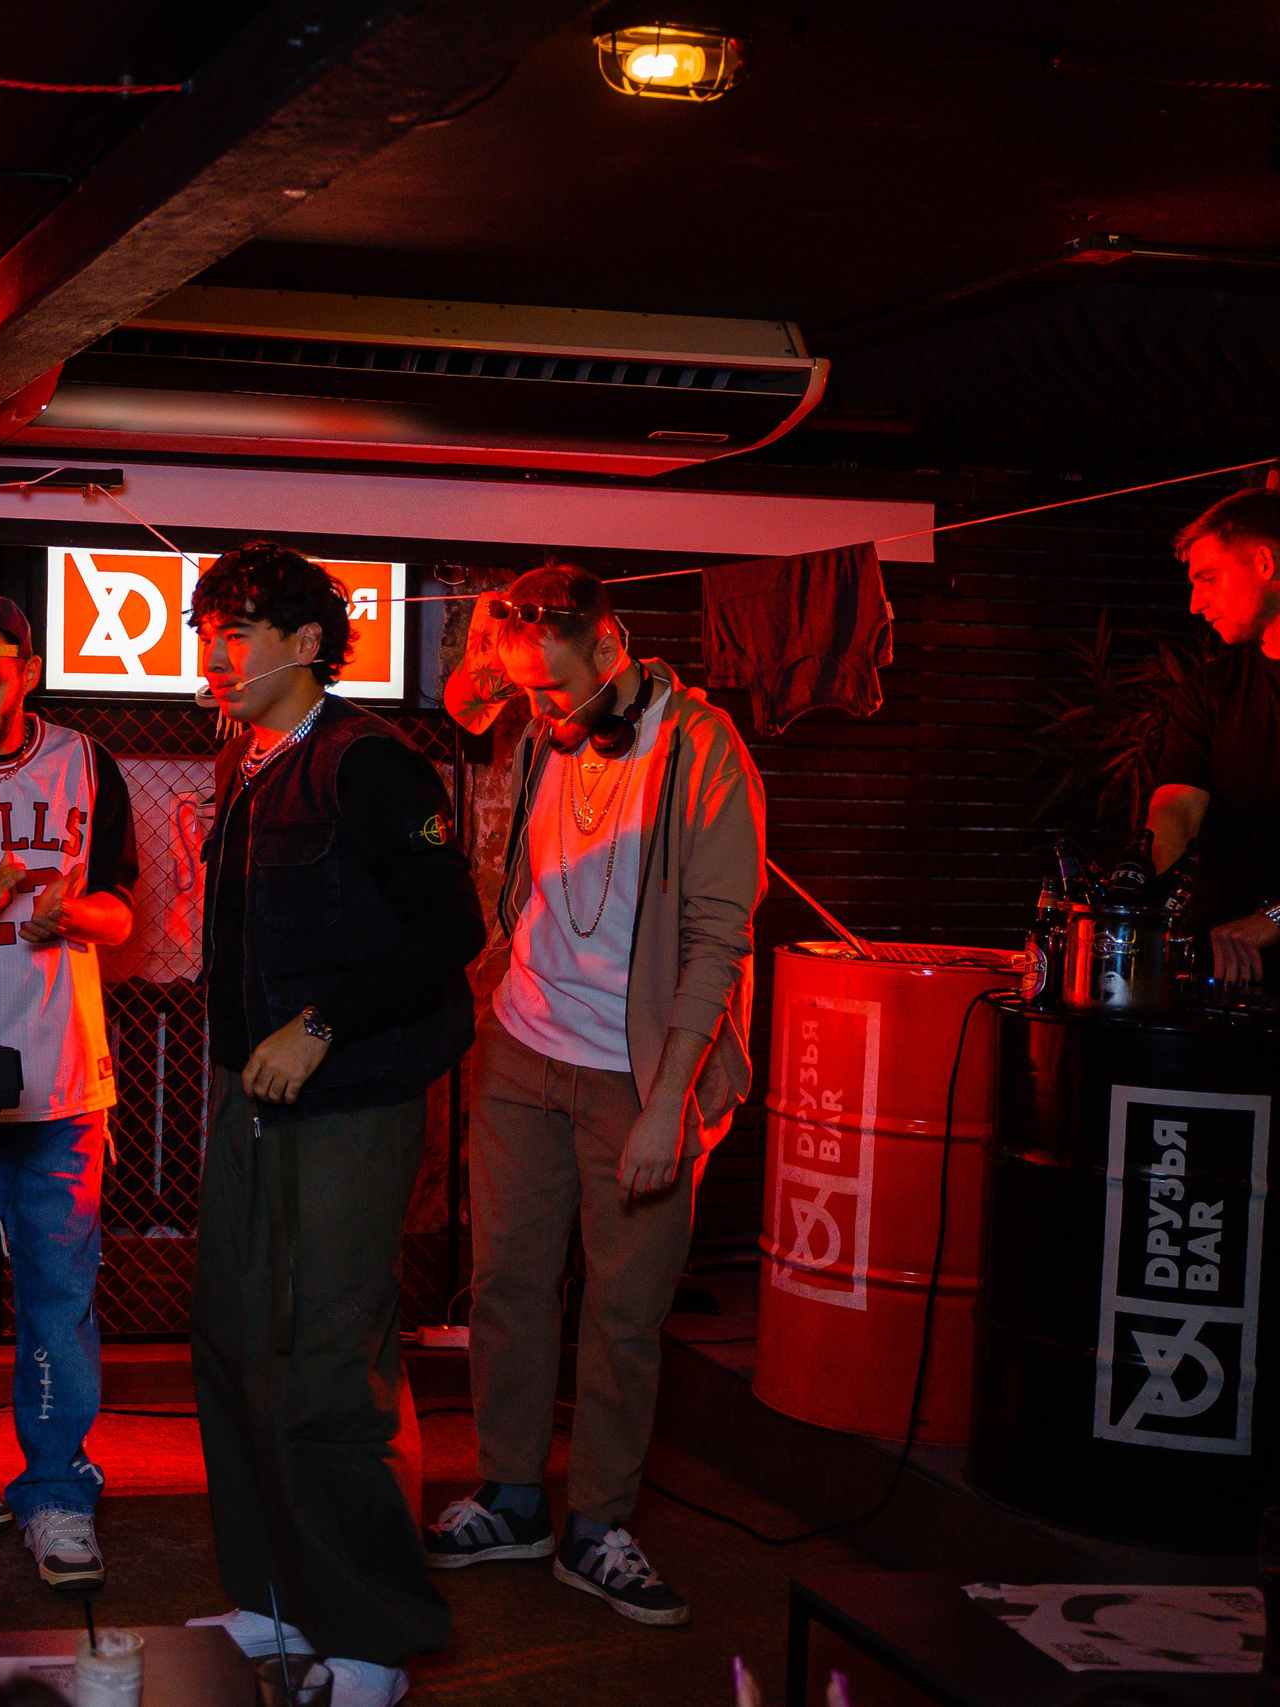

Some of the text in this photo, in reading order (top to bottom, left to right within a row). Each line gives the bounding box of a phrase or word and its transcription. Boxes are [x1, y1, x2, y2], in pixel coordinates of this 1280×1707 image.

[1111, 869, 1147, 885] EFES
[819, 1088, 843, 1163] BAR
[1185, 1199, 1224, 1292] BAR
